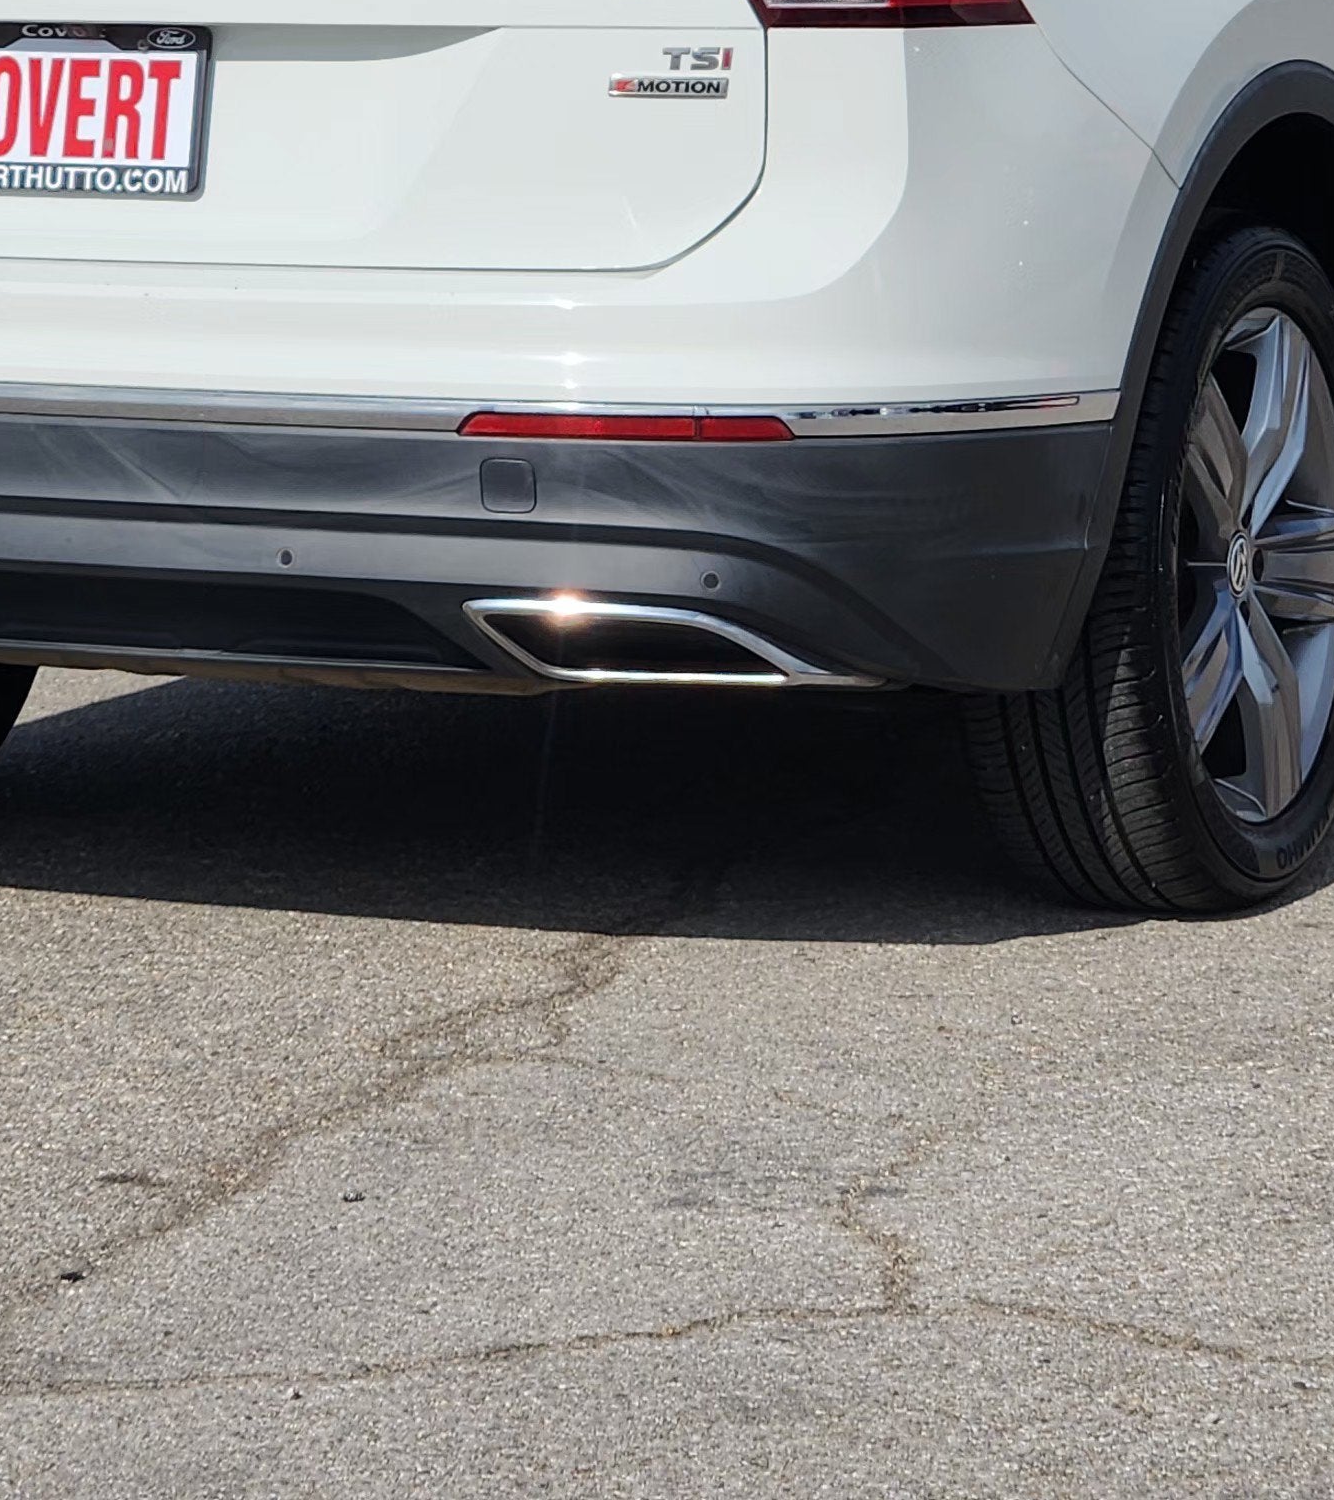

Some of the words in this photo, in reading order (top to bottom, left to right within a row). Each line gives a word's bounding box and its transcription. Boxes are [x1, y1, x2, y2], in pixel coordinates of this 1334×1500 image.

[21, 24, 107, 39] Cov
[156, 31, 186, 46] Ford
[662, 46, 734, 71] TSI
